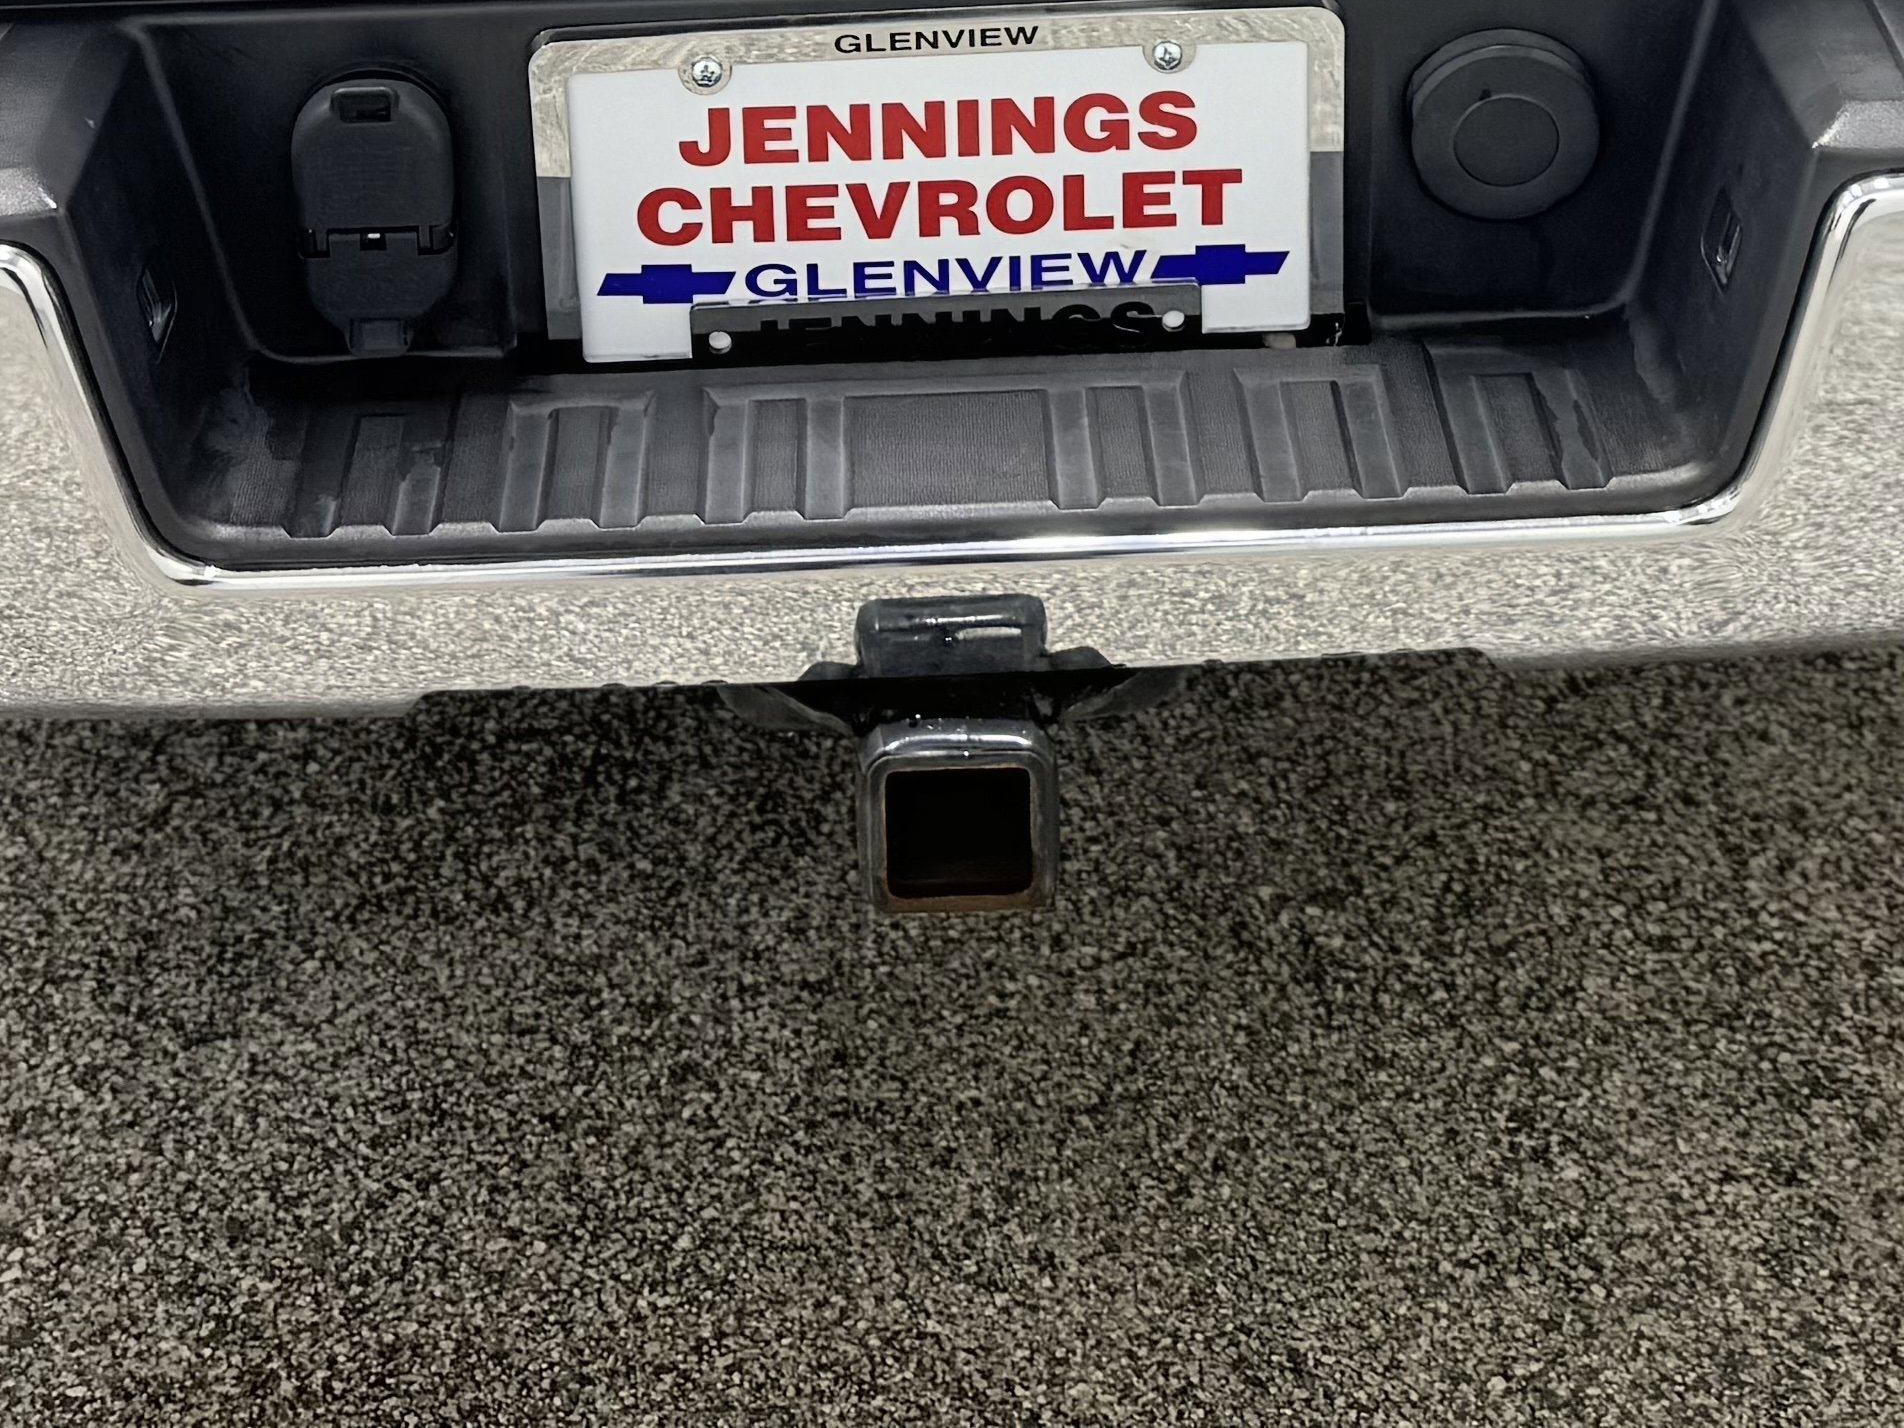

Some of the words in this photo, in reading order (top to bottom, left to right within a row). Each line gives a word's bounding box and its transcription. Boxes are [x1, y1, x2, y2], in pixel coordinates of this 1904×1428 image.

[834, 25, 1039, 54] GLENVIEW
[678, 90, 1198, 166] JENNINGS
[636, 169, 1243, 246] CHEVROLET
[744, 250, 1147, 298] GLENVIEW
